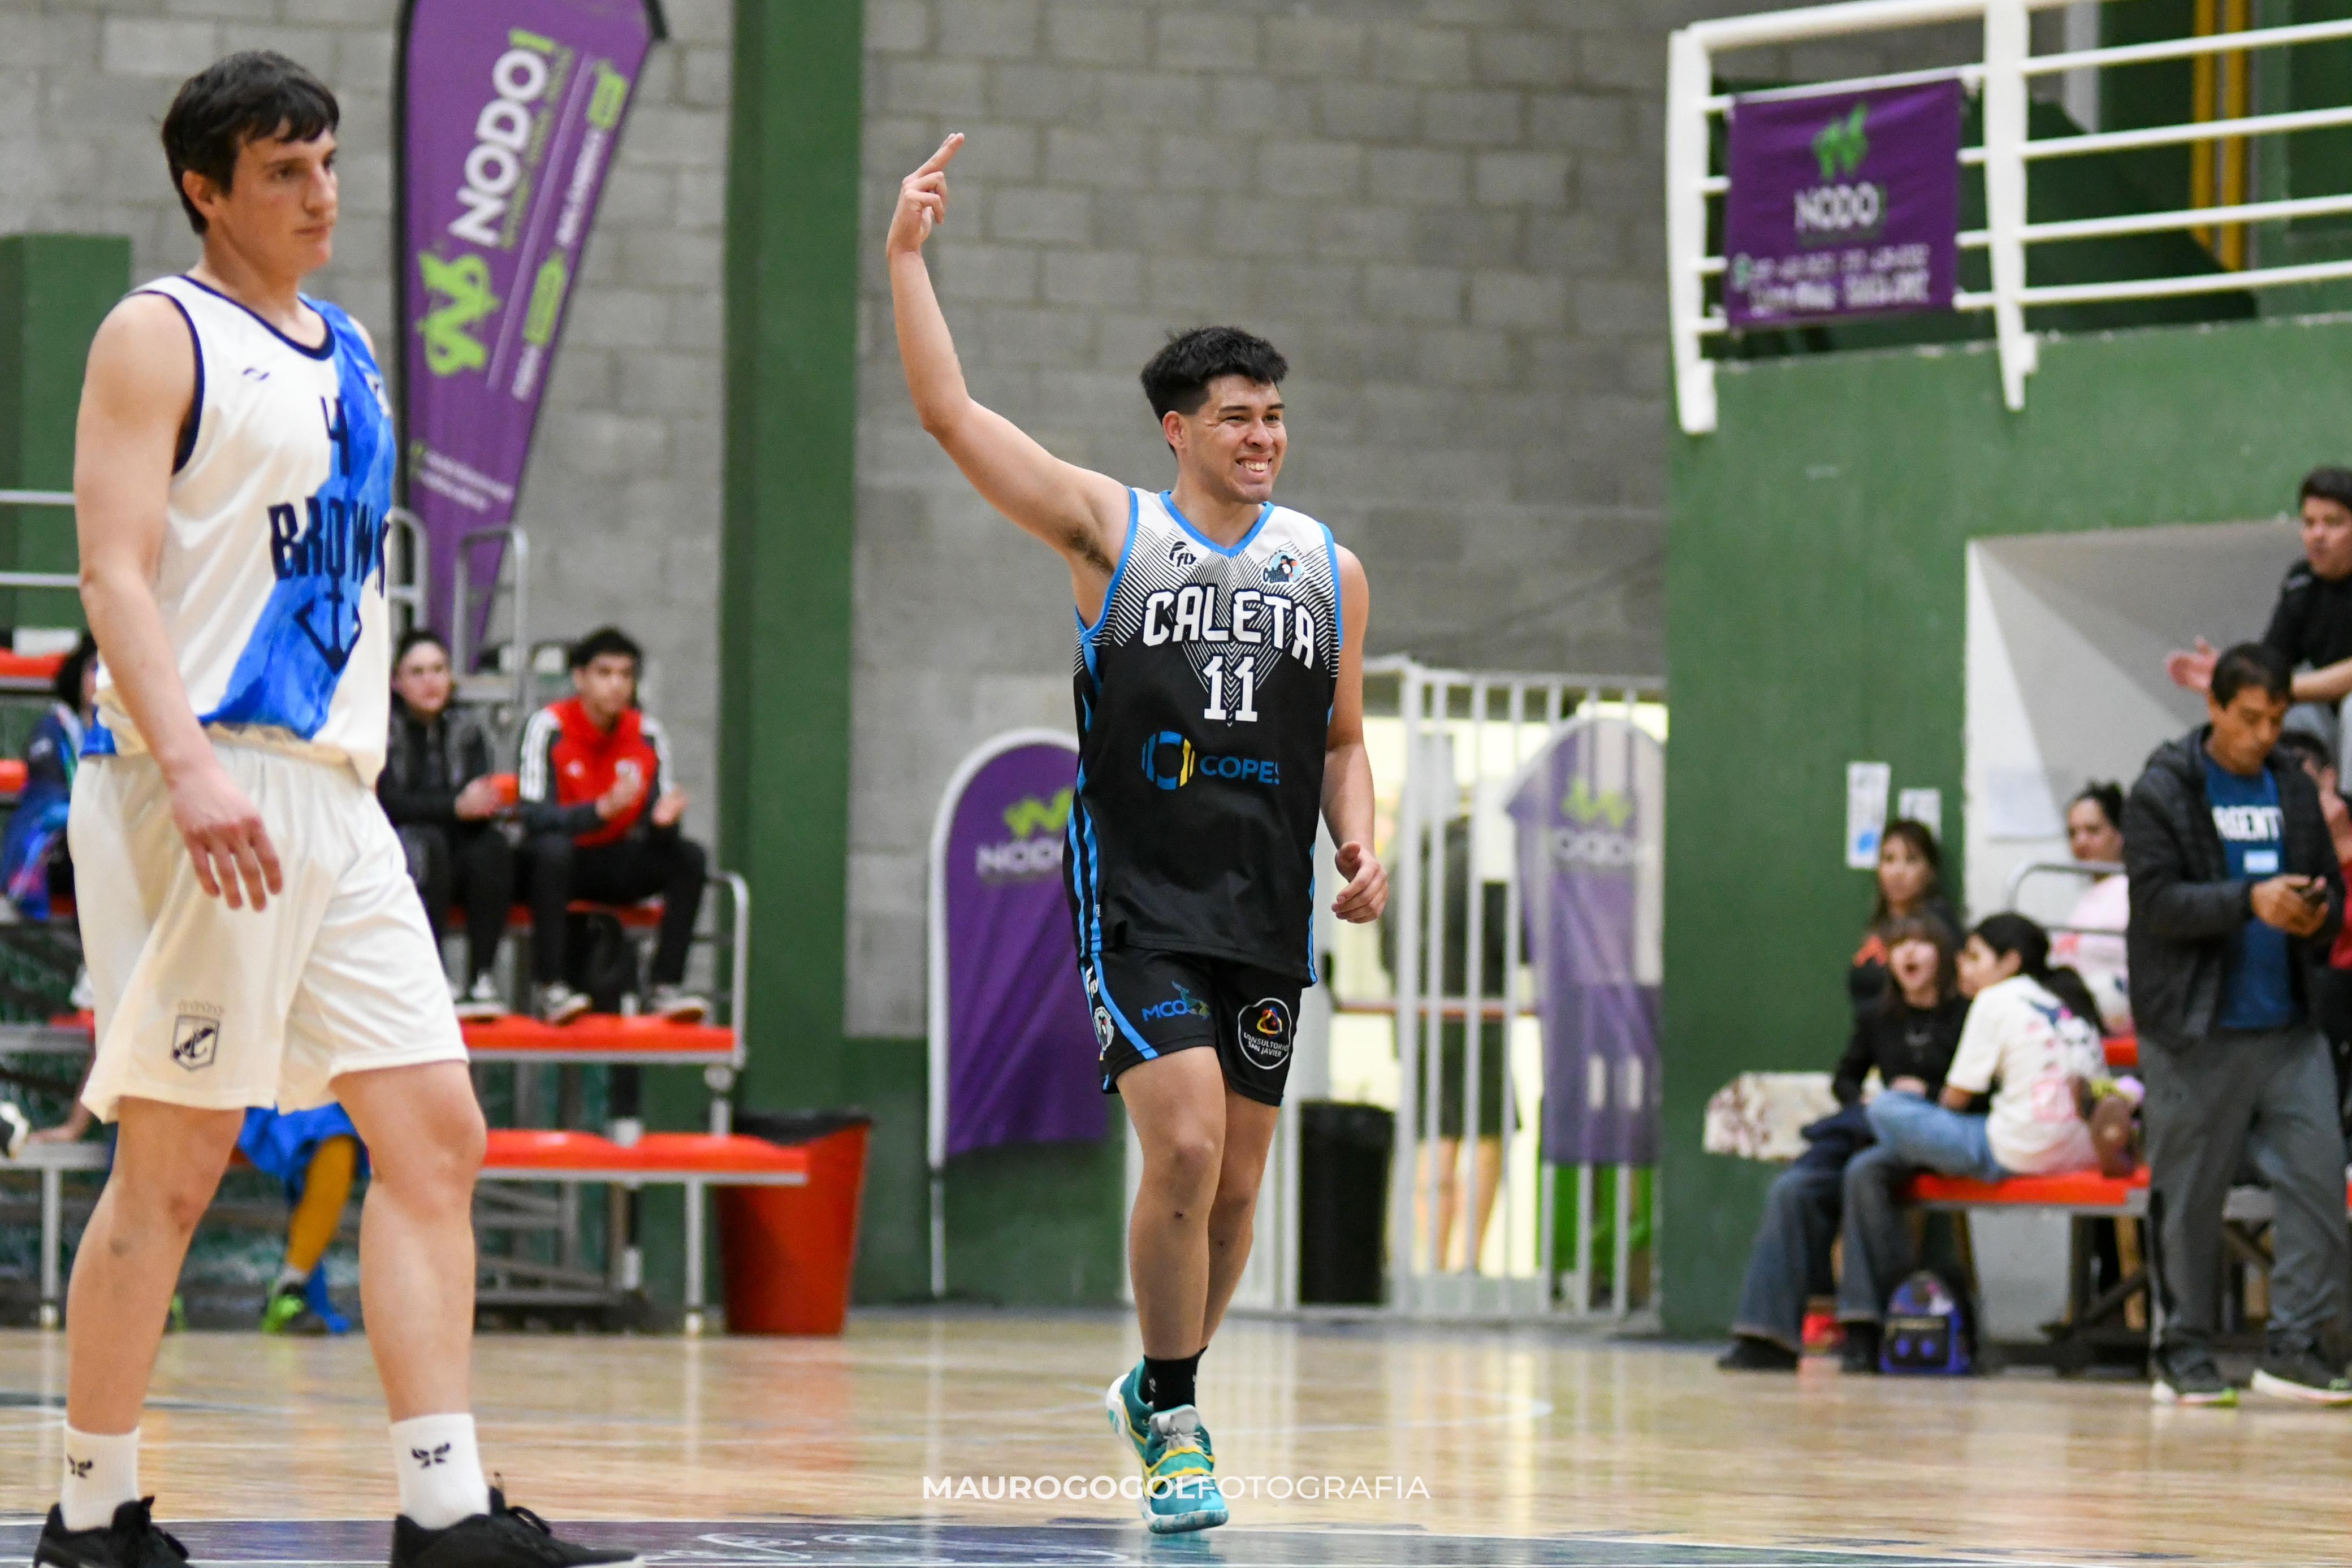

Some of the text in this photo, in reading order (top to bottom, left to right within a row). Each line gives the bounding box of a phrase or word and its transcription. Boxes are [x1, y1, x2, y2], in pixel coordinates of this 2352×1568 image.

[448, 48, 547, 247] NODO
[319, 395, 350, 477] 4
[1143, 586, 1315, 670] CALETA
[1203, 656, 1257, 722] 11
[1247, 1041, 1282, 1057] SAN JAVIER
